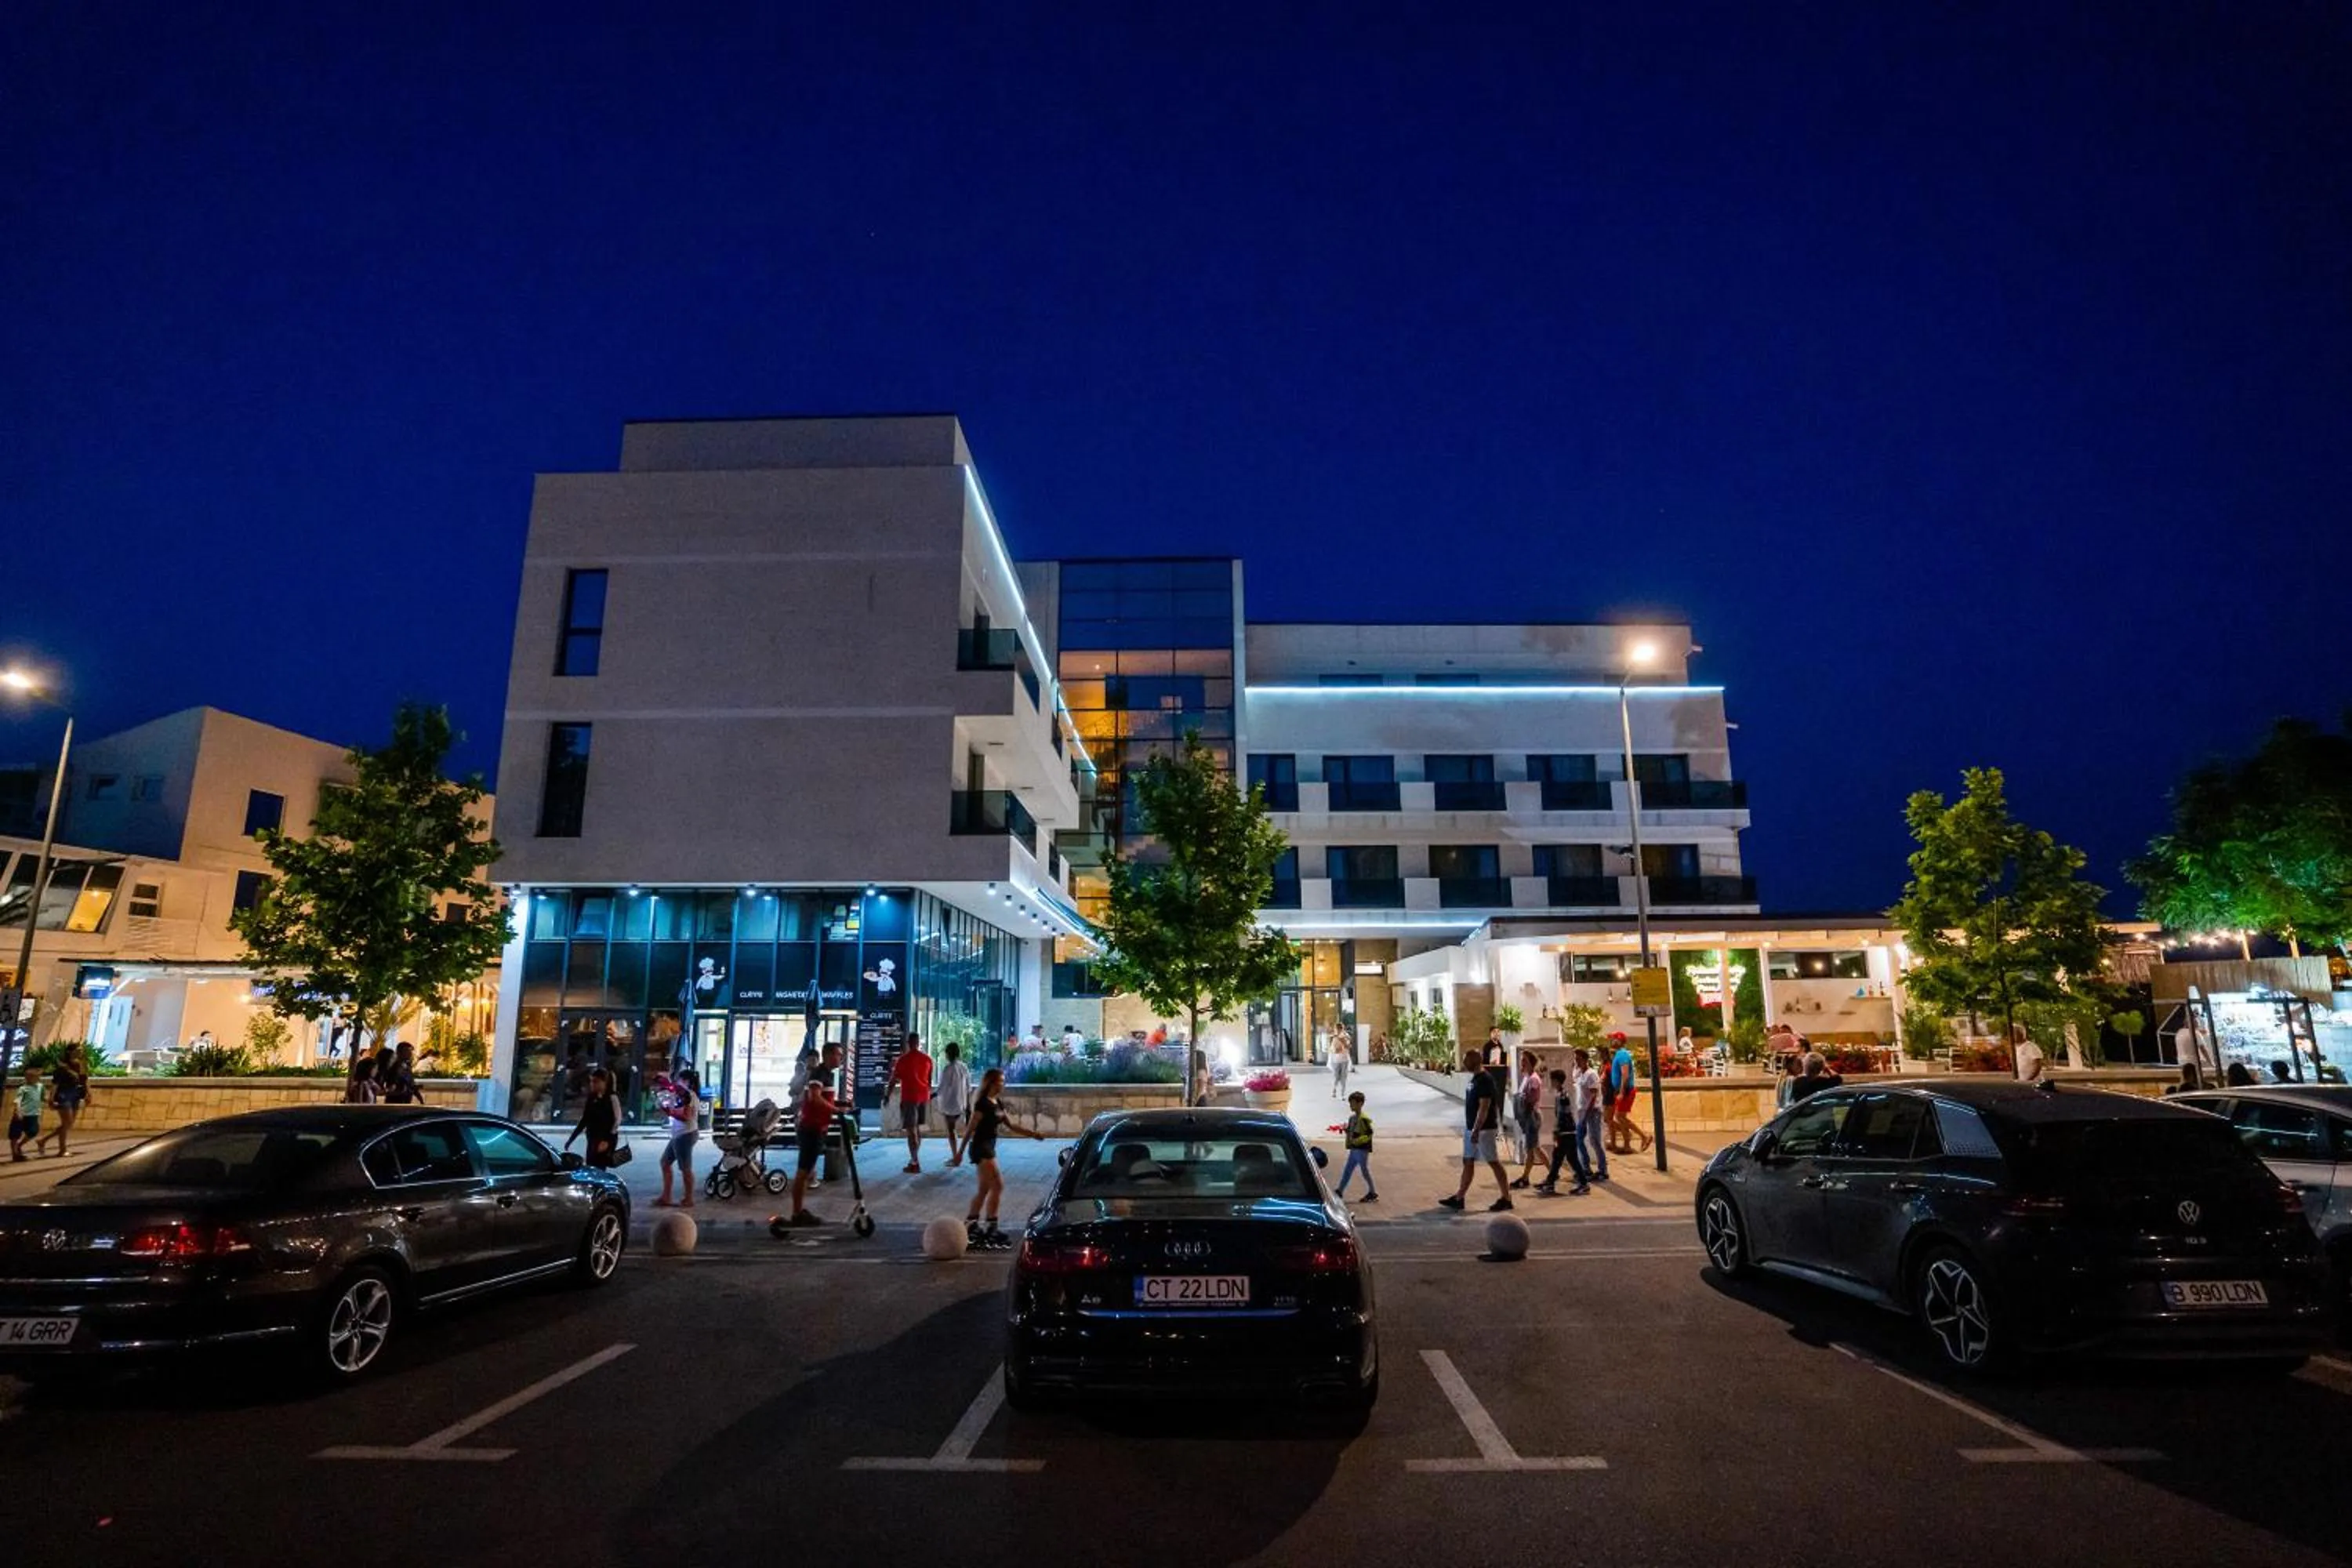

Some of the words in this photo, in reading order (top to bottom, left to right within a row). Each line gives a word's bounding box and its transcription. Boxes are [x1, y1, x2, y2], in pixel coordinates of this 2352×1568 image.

[1146, 1279, 1172, 1299] CT
[1179, 1279, 1202, 1299] 22
[1205, 1279, 1245, 1299] LDN
[2170, 1284, 2186, 1302] B
[2189, 1283, 2223, 1302] 990
[2222, 1282, 2263, 1301] LDN
[9, 1320, 28, 1341] 14
[29, 1320, 72, 1341] GRR
